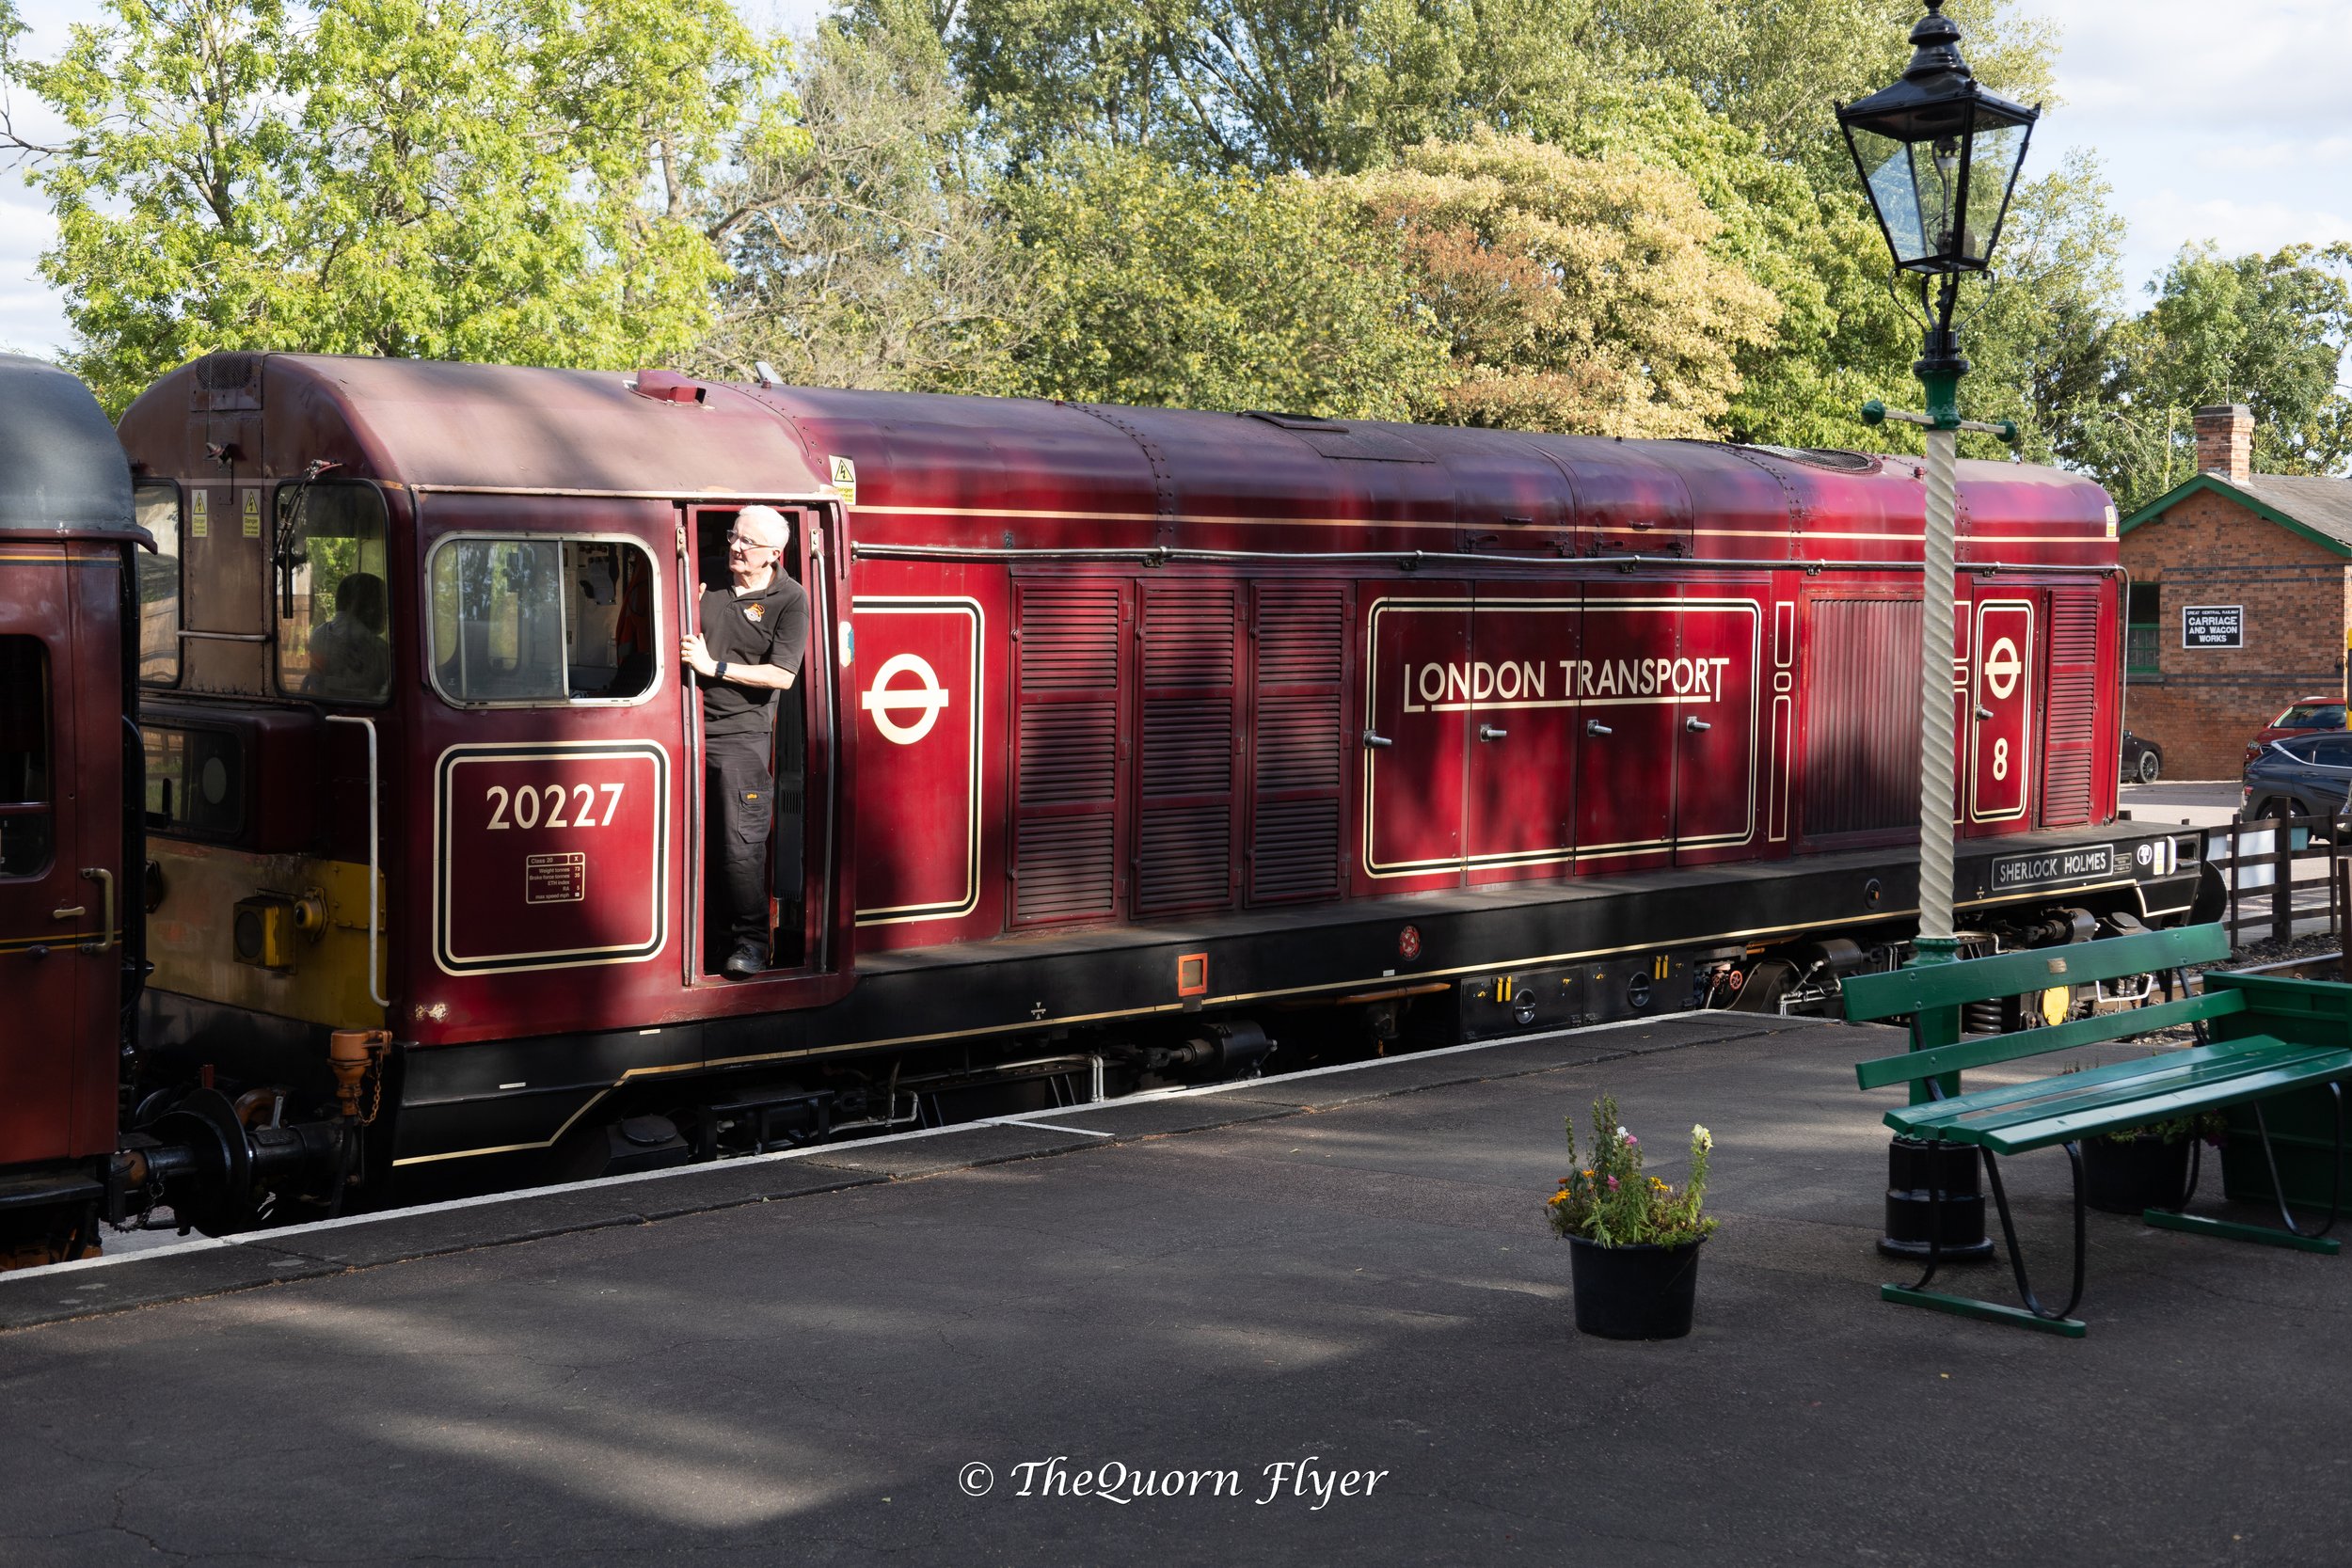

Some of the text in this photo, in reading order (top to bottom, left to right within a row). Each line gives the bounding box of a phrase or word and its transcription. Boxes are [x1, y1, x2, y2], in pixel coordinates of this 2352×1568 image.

[2188, 616, 2238, 626] CARRIAGE
[2209, 626, 2238, 634] WAGON
[2199, 634, 2227, 642] WORKS
[1404, 657, 1730, 713] LONDON TRANSPORT
[1993, 737, 2009, 781] 8
[486, 783, 626, 830] 20227
[1999, 858, 2058, 882] SHERLOCK
[2064, 852, 2106, 875] HOLMES
